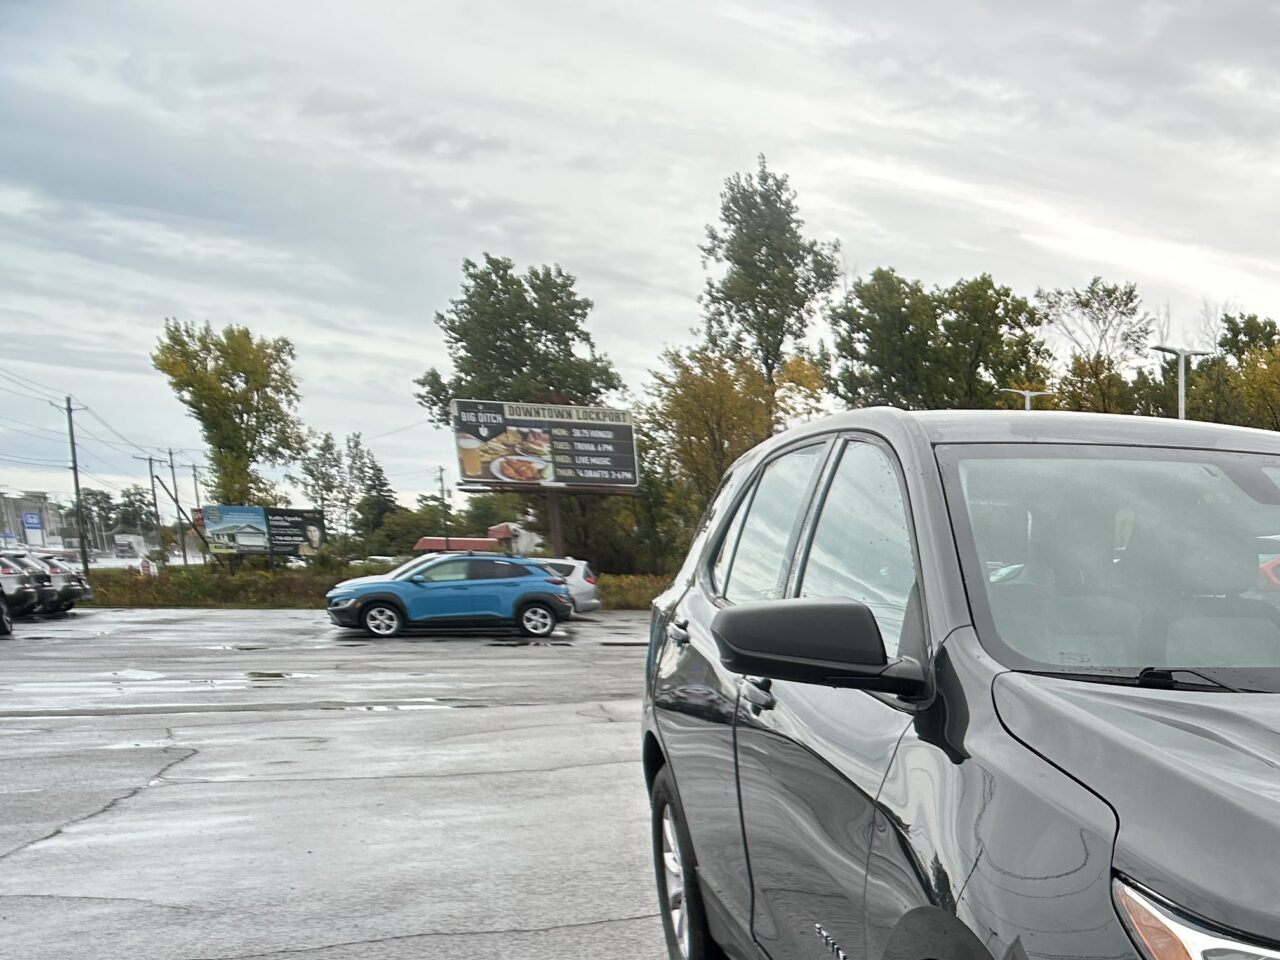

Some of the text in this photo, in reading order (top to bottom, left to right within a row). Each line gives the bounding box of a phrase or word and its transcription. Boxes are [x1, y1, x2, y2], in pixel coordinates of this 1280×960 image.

[461, 411, 503, 424] BIG DITCH
[508, 405, 628, 423] DOWNTOWN LOCKPORT
[575, 456, 590, 464] LIVE
[590, 456, 613, 465] MUSIC
[583, 469, 610, 478] DRAFTS
